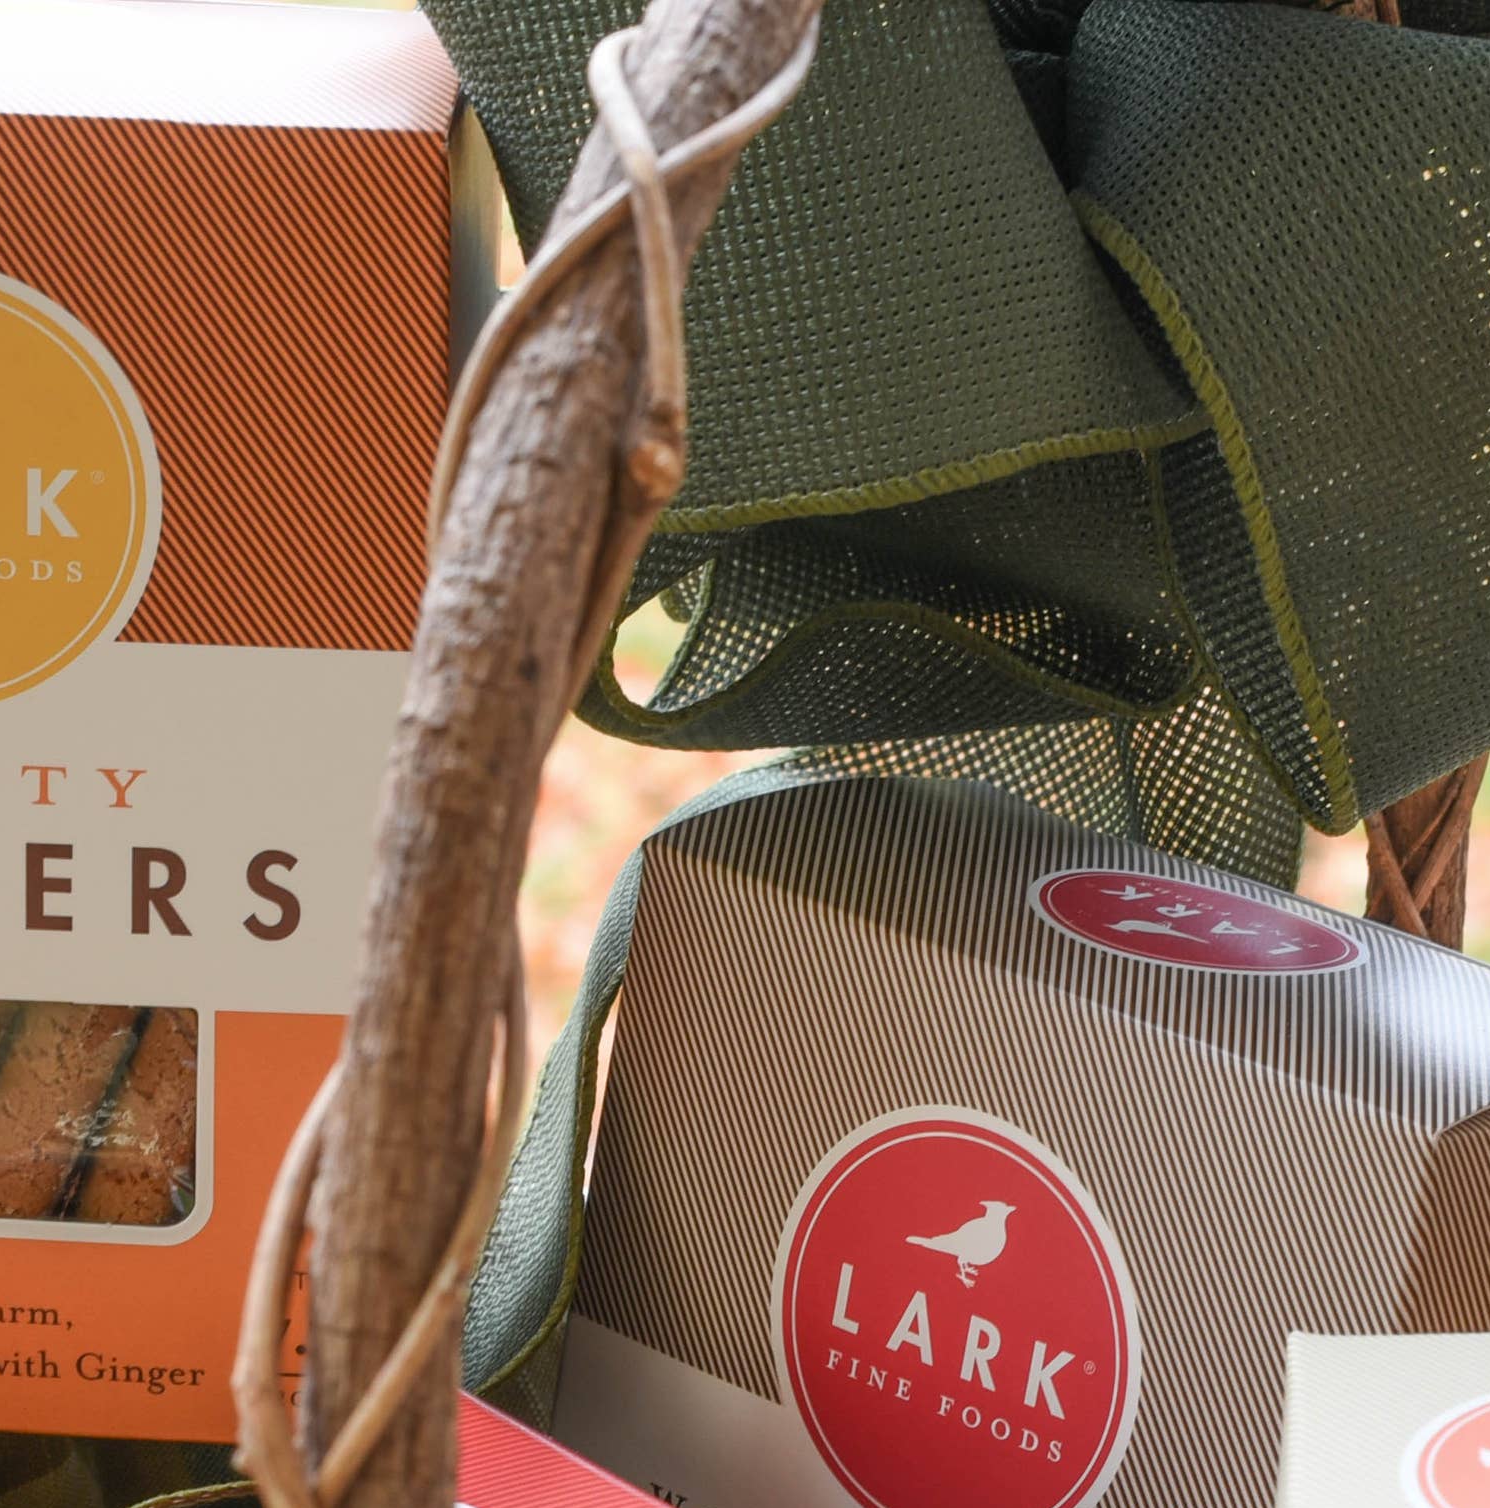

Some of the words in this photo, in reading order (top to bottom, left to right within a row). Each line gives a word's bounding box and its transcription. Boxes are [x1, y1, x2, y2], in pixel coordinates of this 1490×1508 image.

[76, 1355, 206, 1396] Ginger
[826, 1348, 911, 1401] FINE
[937, 1395, 1063, 1463] FOODS
